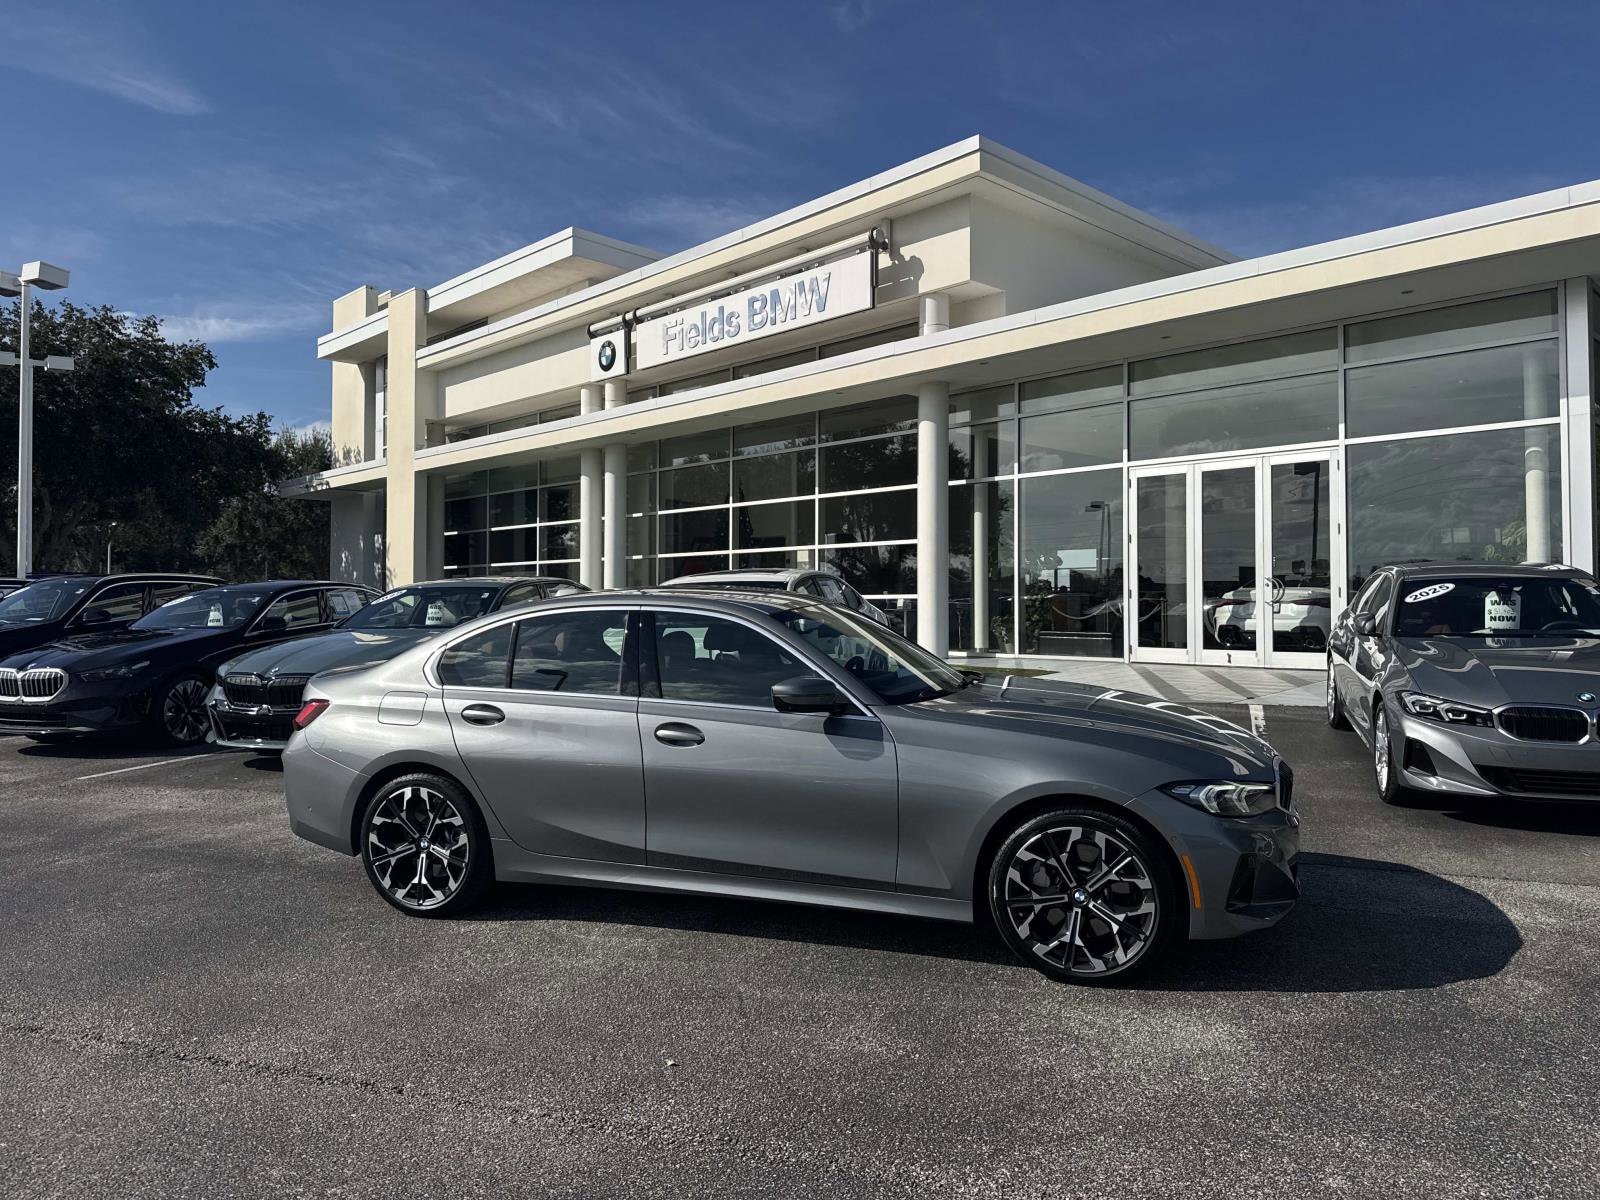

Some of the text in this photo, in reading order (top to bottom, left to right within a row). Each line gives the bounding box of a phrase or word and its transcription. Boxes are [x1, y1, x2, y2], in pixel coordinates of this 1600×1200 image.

[662, 271, 832, 356] Fields BMW
[1409, 584, 1450, 601] 2025
